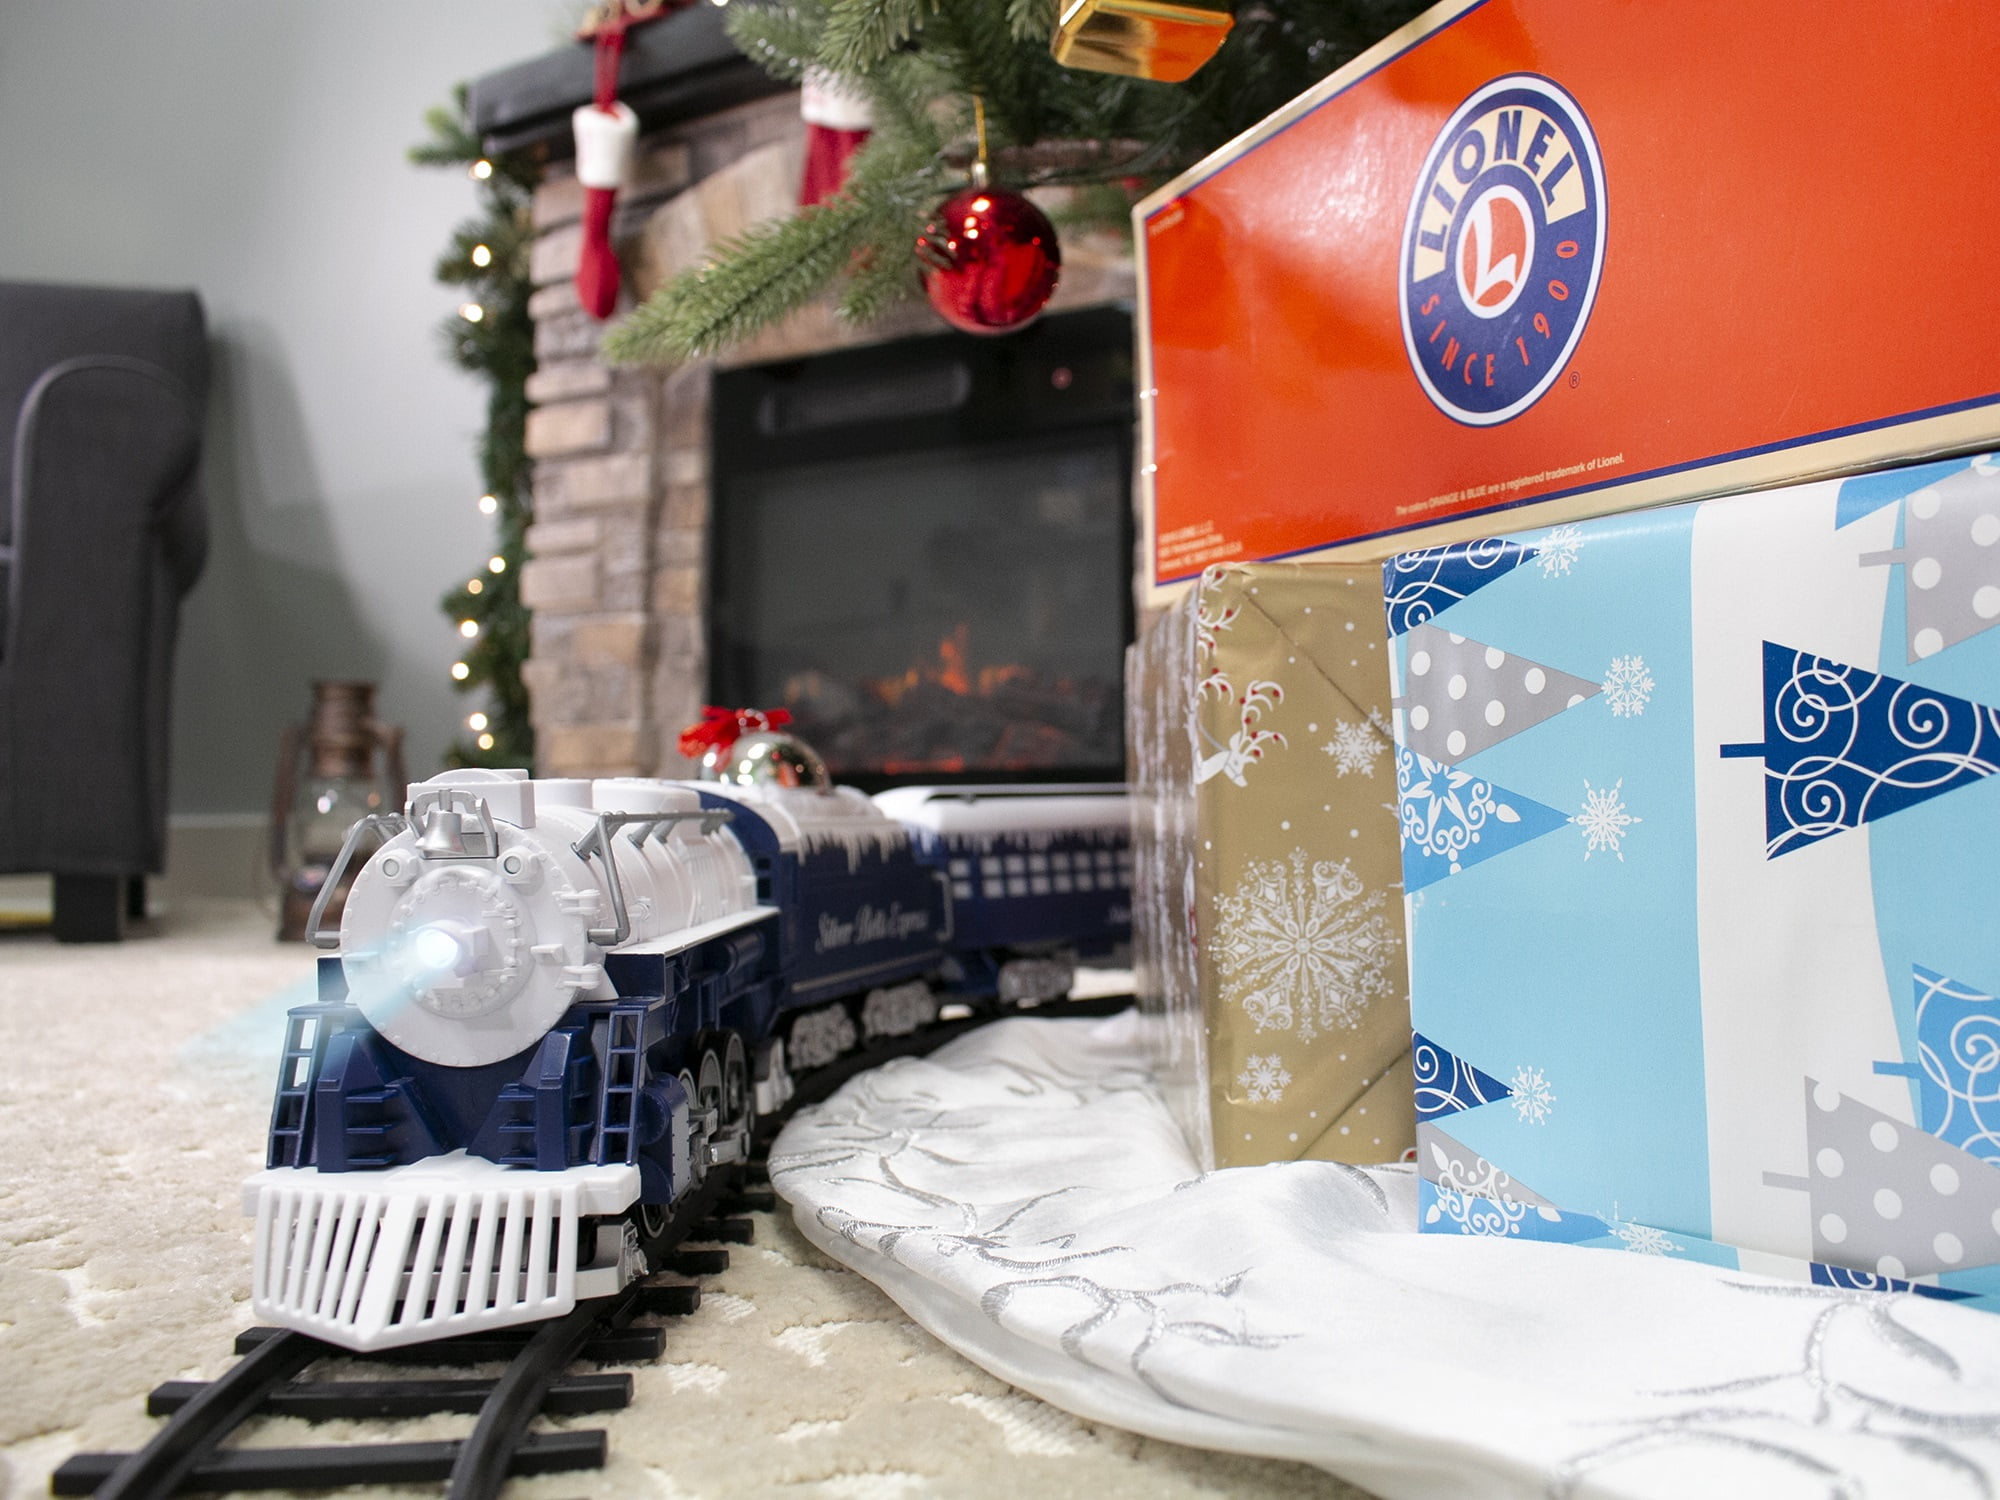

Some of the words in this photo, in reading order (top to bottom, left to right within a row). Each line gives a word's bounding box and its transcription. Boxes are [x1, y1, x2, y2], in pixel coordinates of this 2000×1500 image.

[1420, 110, 1575, 253] LIONEL
[1420, 294, 1495, 387] SINCE
[1515, 239, 1580, 366] 1900
[1429, 491, 1459, 509] ORANGE
[1460, 490, 1466, 501] &
[1467, 485, 1487, 500] BLUE
[1488, 483, 1500, 495] are
[1500, 482, 1506, 492] a
[1507, 472, 1545, 491] registered
[1546, 461, 1586, 481] trademark
[1587, 458, 1597, 471] of
[1597, 452, 1625, 469] Lionel.
